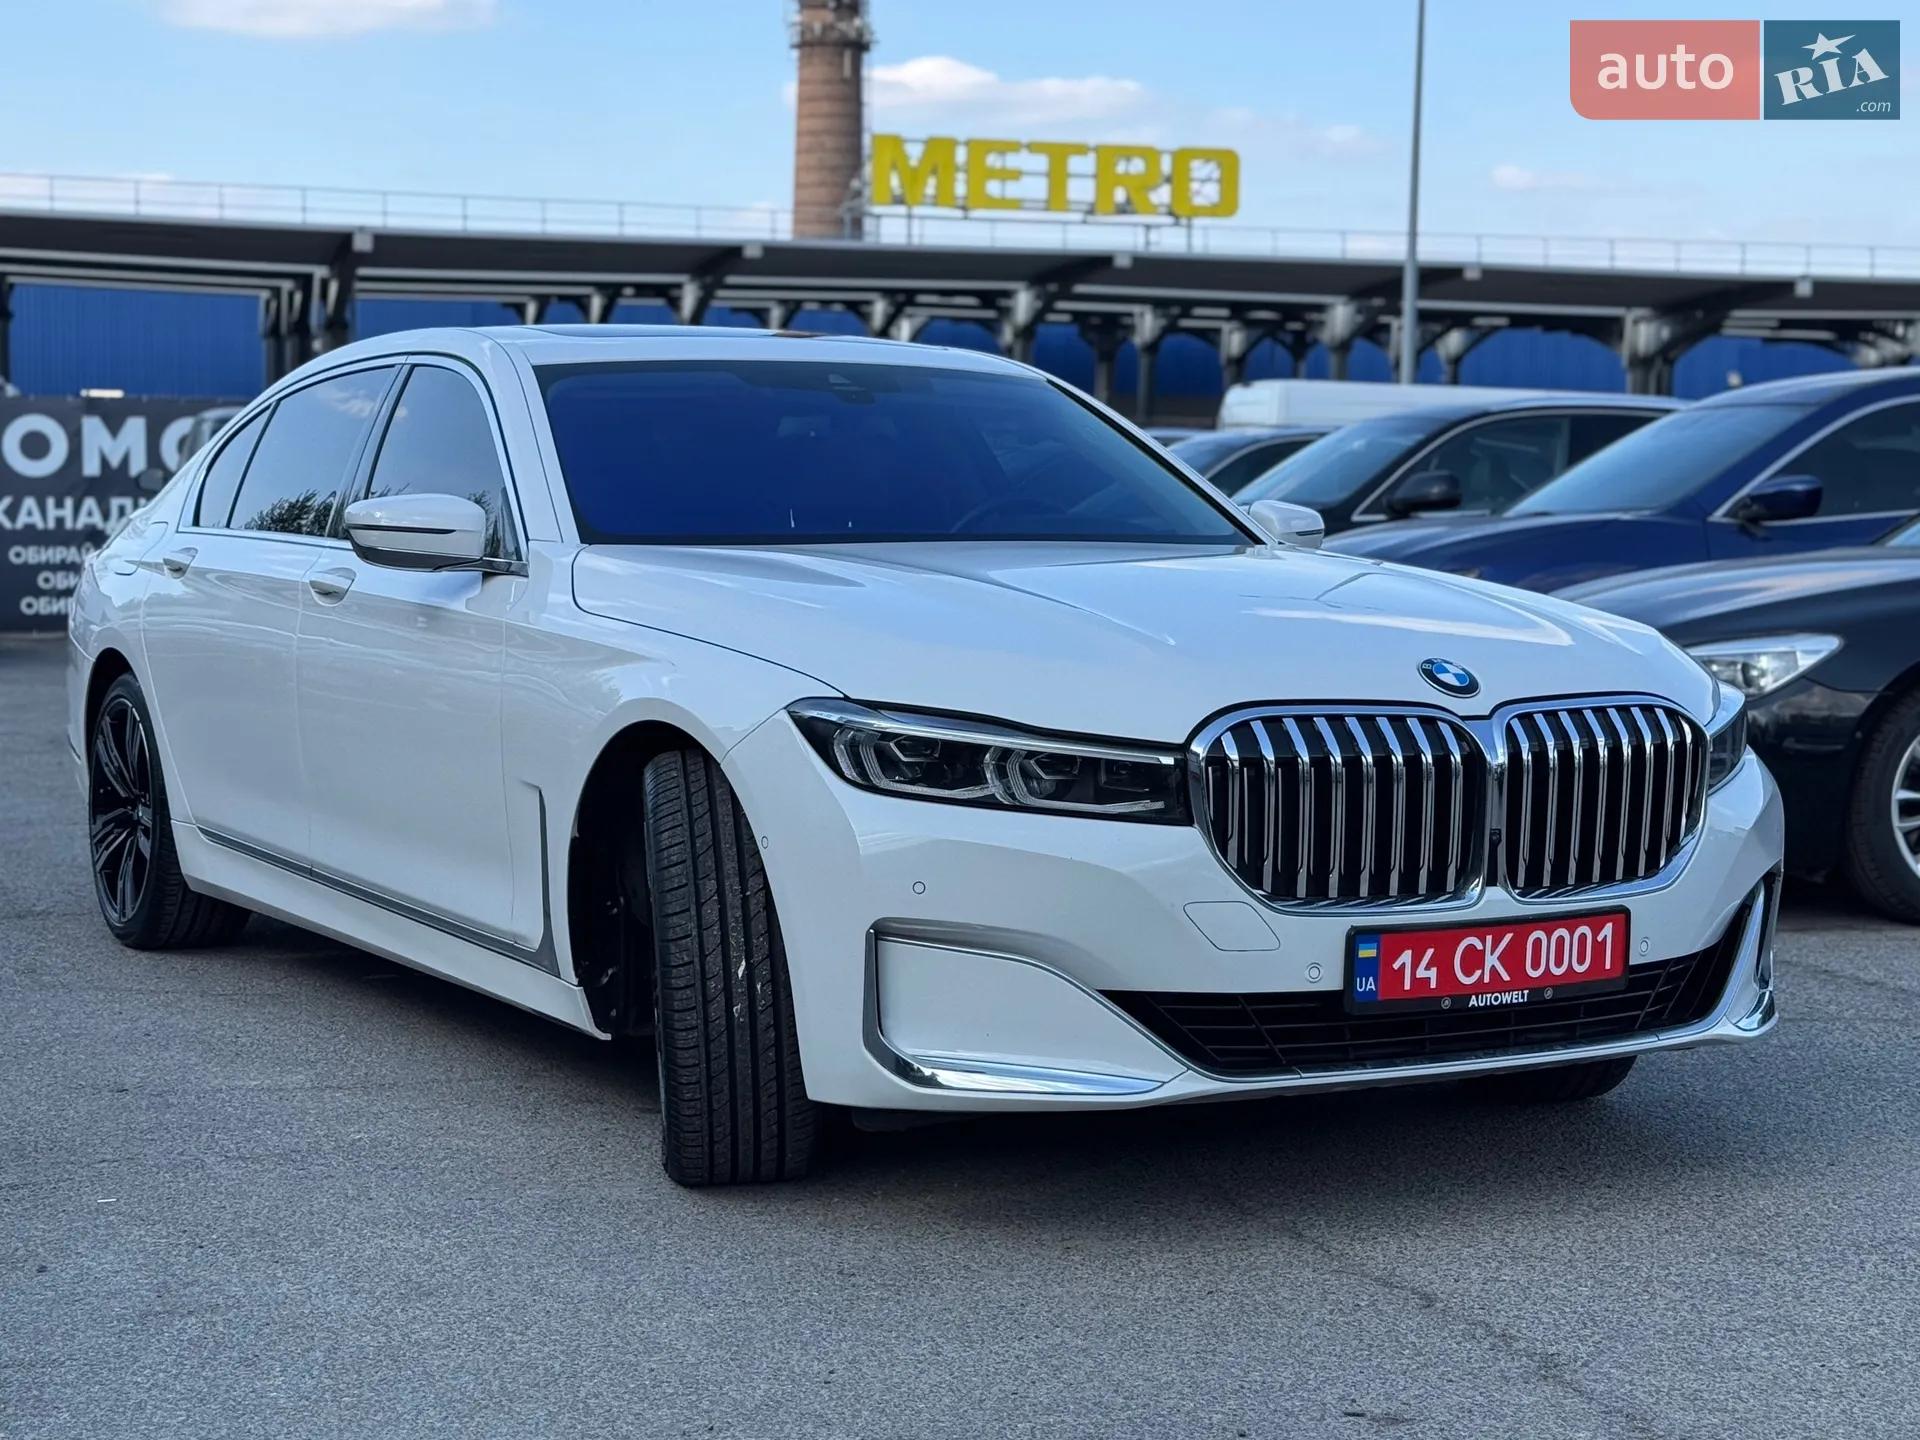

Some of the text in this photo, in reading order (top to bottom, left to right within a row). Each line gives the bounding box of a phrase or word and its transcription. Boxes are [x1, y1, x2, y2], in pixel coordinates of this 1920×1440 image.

[871, 134, 1239, 217] METRO
[0, 495, 147, 536] КАНАД
[1392, 922, 1613, 990] 14 CK 0001
[1356, 976, 1376, 992] UA
[1468, 989, 1529, 1008] AUTOWELT
